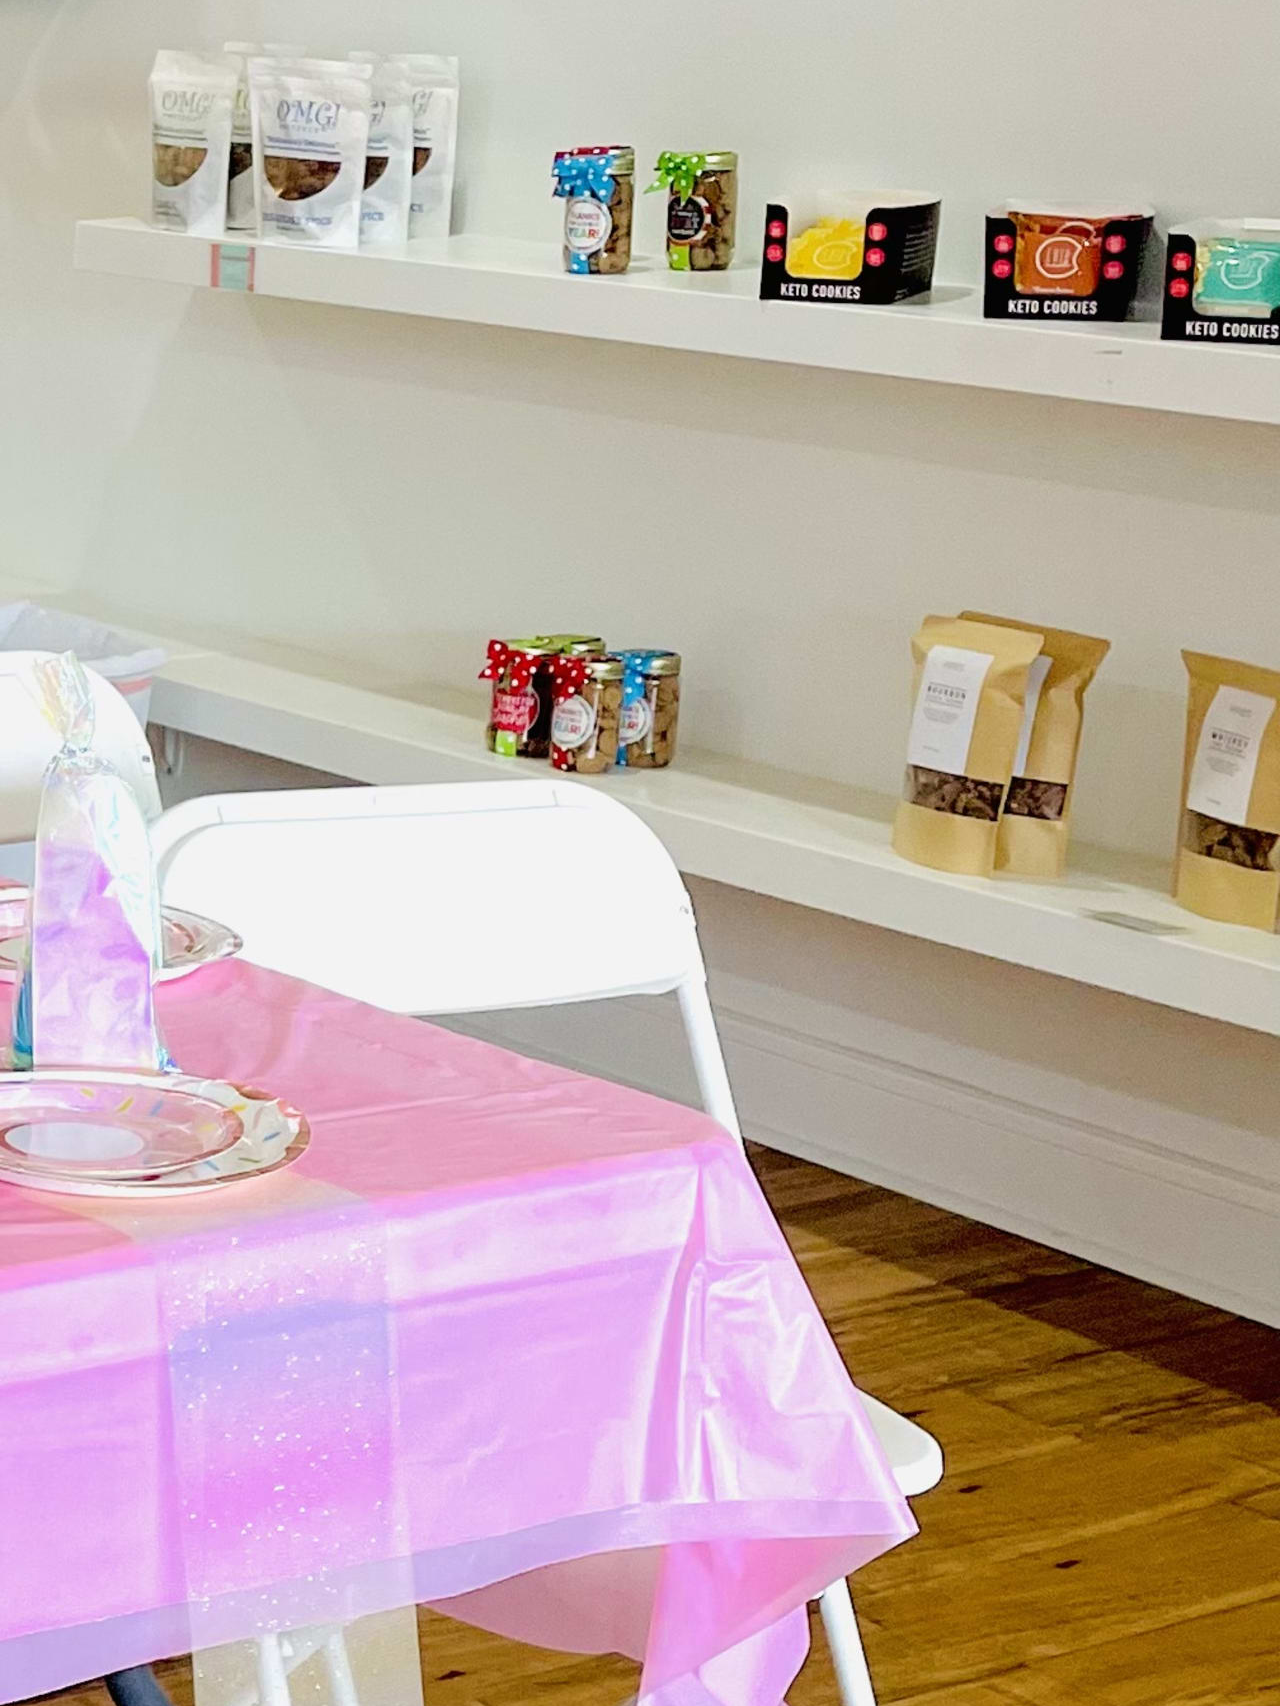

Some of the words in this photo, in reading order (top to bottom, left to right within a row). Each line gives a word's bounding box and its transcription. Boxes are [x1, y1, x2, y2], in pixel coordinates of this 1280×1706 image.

[276, 98, 341, 127] OMG!
[780, 282, 808, 297] KETO
[811, 284, 861, 300] COOKIES
[1007, 299, 1040, 314] KETO
[1043, 300, 1098, 315] COOKIES
[1185, 320, 1219, 336] KETO
[1222, 322, 1280, 339] COOKIES
